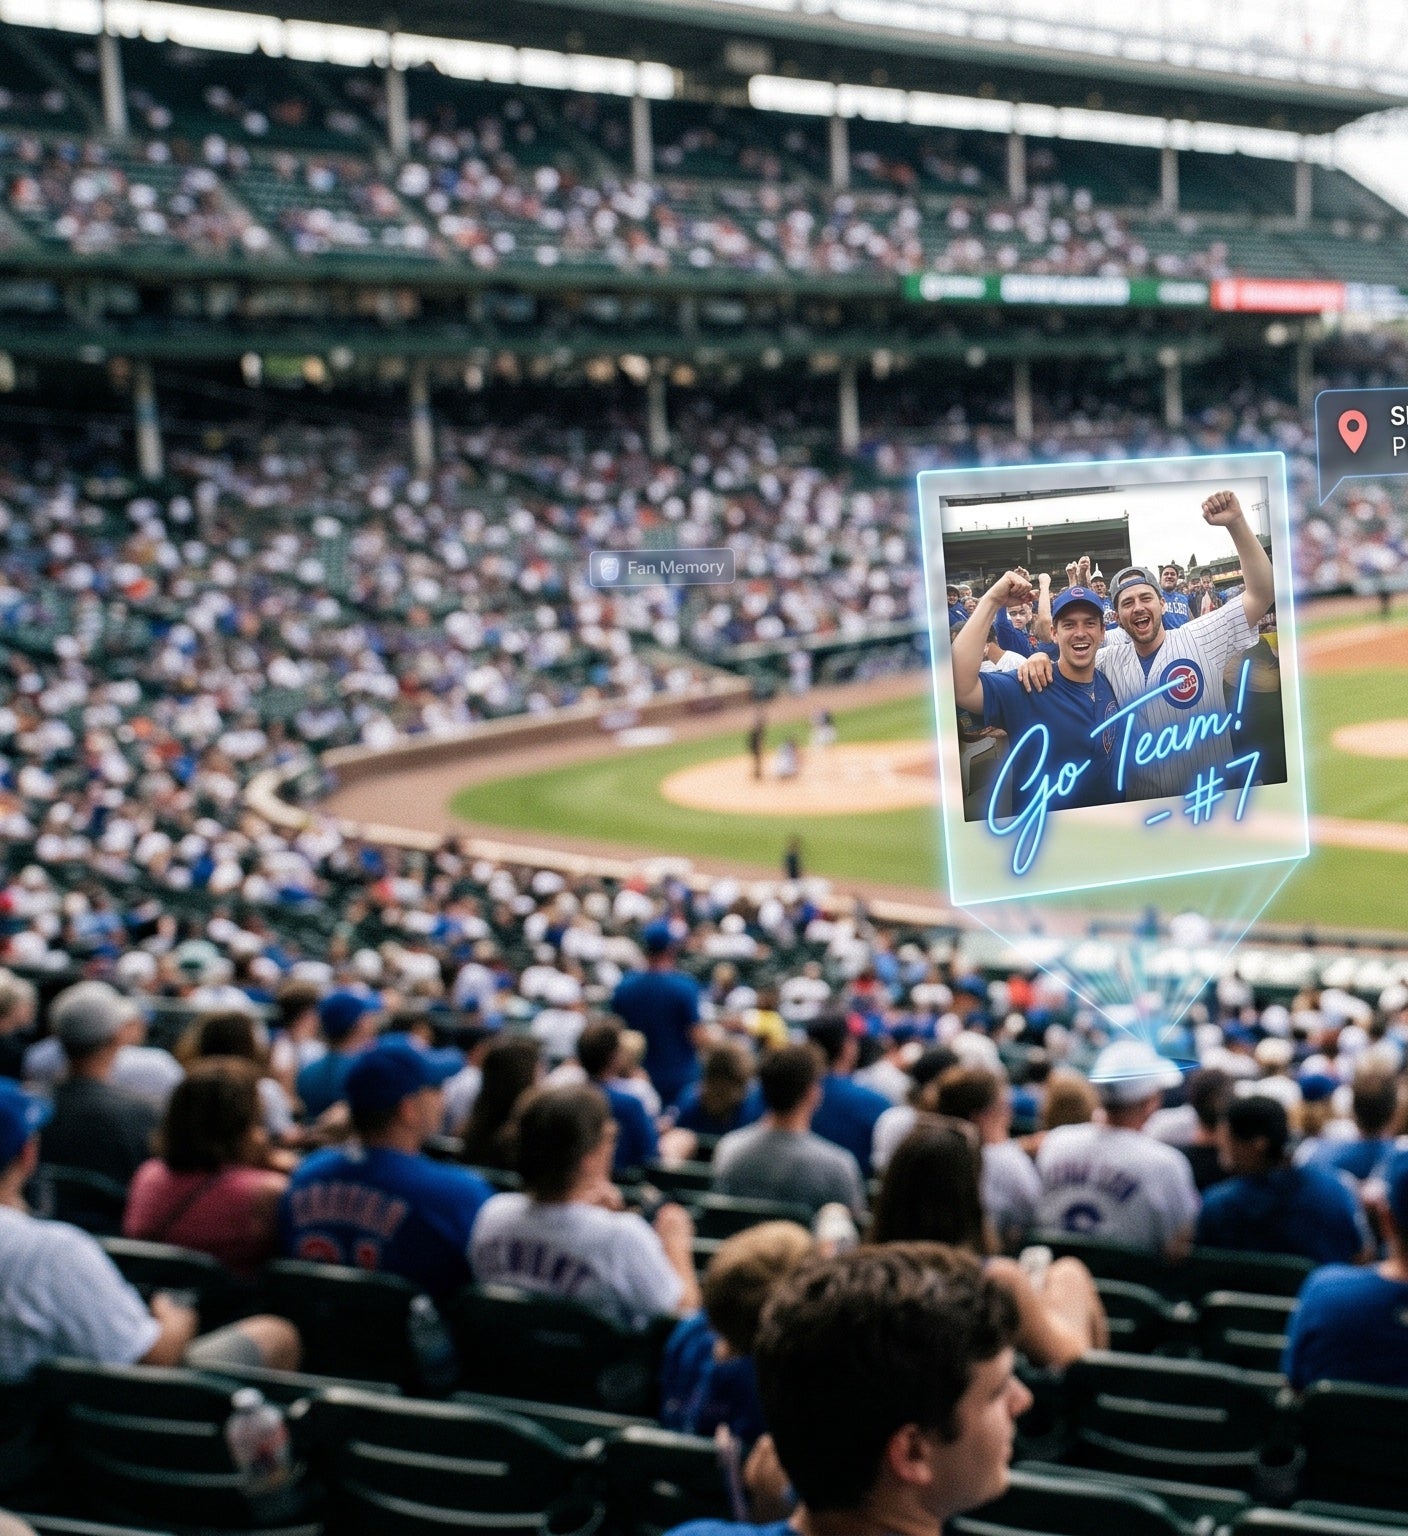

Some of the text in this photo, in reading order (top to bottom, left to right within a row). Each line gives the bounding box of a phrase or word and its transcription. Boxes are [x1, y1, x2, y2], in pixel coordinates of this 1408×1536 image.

[988, 658, 1250, 876] Go Team!
[1184, 751, 1261, 826] #7
